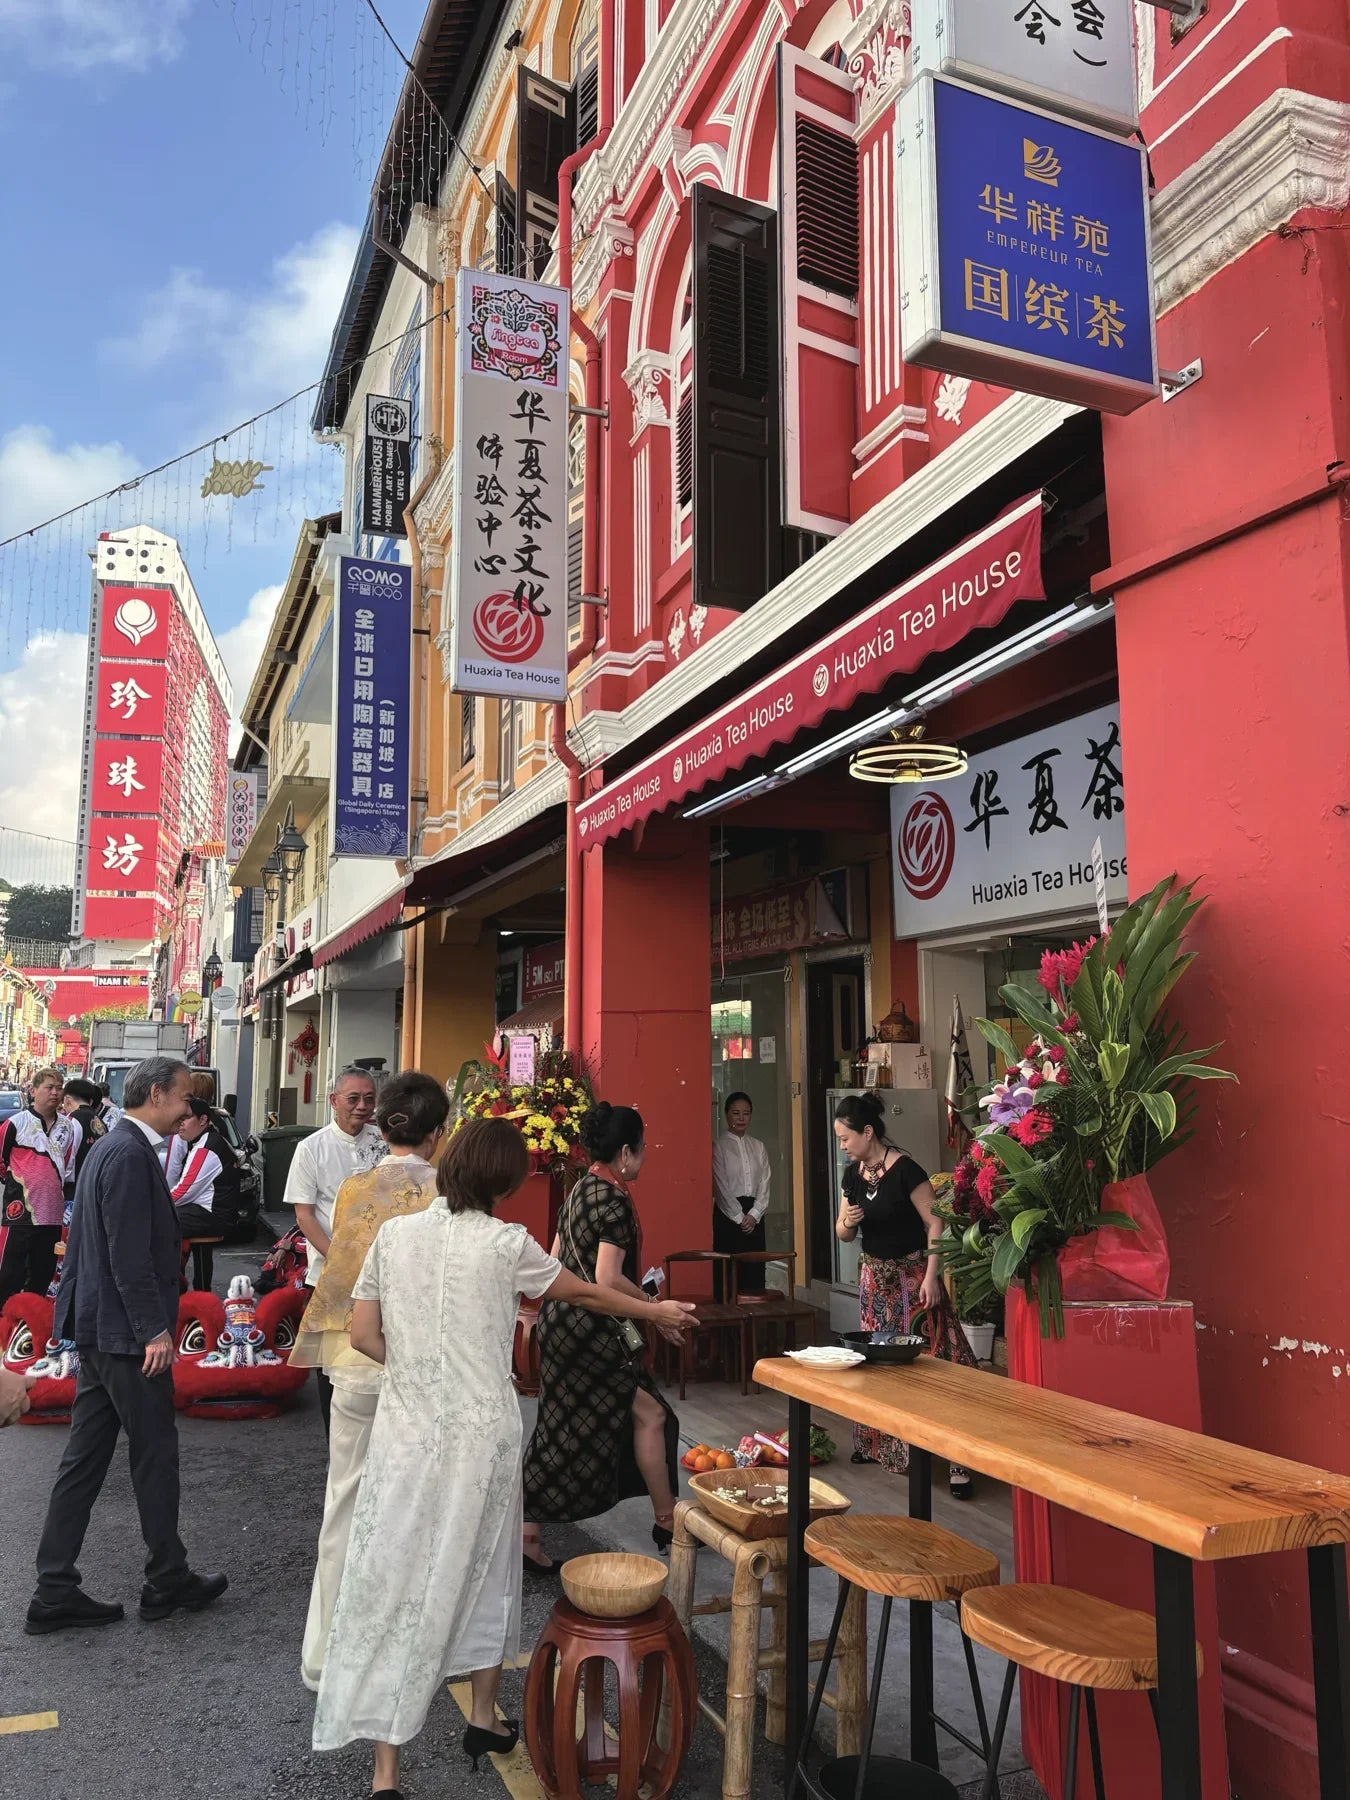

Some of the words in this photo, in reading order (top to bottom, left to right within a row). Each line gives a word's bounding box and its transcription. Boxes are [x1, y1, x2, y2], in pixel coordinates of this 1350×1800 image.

[978, 184, 1110, 257] 华祥苑
[987, 230, 1068, 266] EMPEREUR
[1075, 257, 1103, 277] TEA
[964, 258, 1126, 349] 国缤茶
[500, 352, 528, 364] Room
[386, 441, 394, 469] GAMES
[372, 437, 383, 526] HAMMERHOUSE
[396, 478, 404, 500] LEVEL
[385, 499, 393, 527] HOBBY
[474, 433, 508, 575] 体验中心
[510, 389, 552, 617] 华夏茶文化
[348, 566, 402, 586] QOMO
[372, 586, 402, 600] 1996
[833, 626, 895, 684] Huaxia
[898, 603, 936, 641] Tea
[941, 551, 1021, 618] House
[464, 664, 502, 678] Huaxia
[504, 668, 524, 680] Tea
[526, 671, 560, 684] House
[352, 608, 374, 798] 全球日用陶瓷器具
[685, 734, 722, 774] Huaxia
[725, 721, 748, 748] Tea
[750, 692, 794, 734] House
[102, 677, 152, 876] 珍珠坊
[963, 722, 1124, 851] 华夏茶
[344, 806, 382, 815] (Singapore)
[359, 800, 374, 808] Daily
[590, 802, 616, 832] Huaxia
[616, 795, 632, 818] Tea
[632, 775, 661, 805] House
[972, 874, 1028, 905] Huaxia
[1032, 870, 1064, 892] Tea
[100, 977, 120, 986] NAM
[532, 965, 543, 986] 5M
